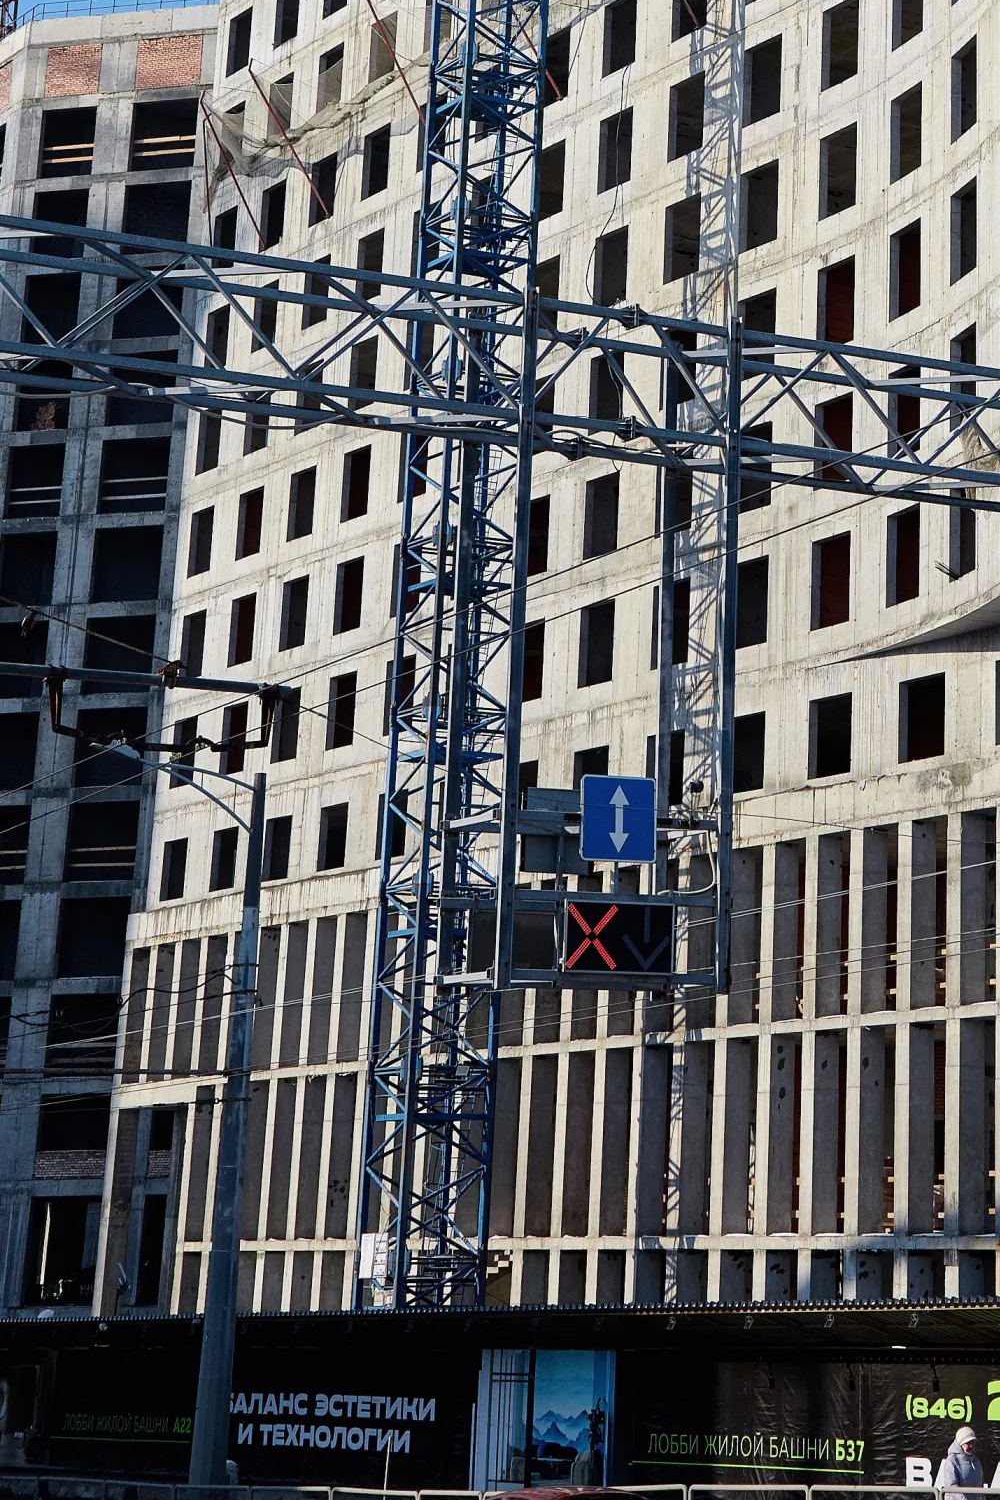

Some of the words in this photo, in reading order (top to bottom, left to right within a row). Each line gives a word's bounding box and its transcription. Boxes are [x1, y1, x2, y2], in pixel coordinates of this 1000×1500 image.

[314, 1393, 436, 1422] ЭСТЕТИКИ
[905, 1394, 973, 1423] (846)
[62, 1413, 95, 1431] ЛОББИ
[95, 1412, 132, 1433] ЖИЛОЙ
[133, 1415, 170, 1433] БАШНИ
[237, 1423, 254, 1445] И
[259, 1423, 411, 1454] ТЕХНОЛОГИИ
[648, 1433, 699, 1455] ЛОББИ
[704, 1431, 764, 1458] ЖИЛОЙ
[769, 1435, 830, 1461] БАШНИ
[835, 1438, 865, 1462] Б37
